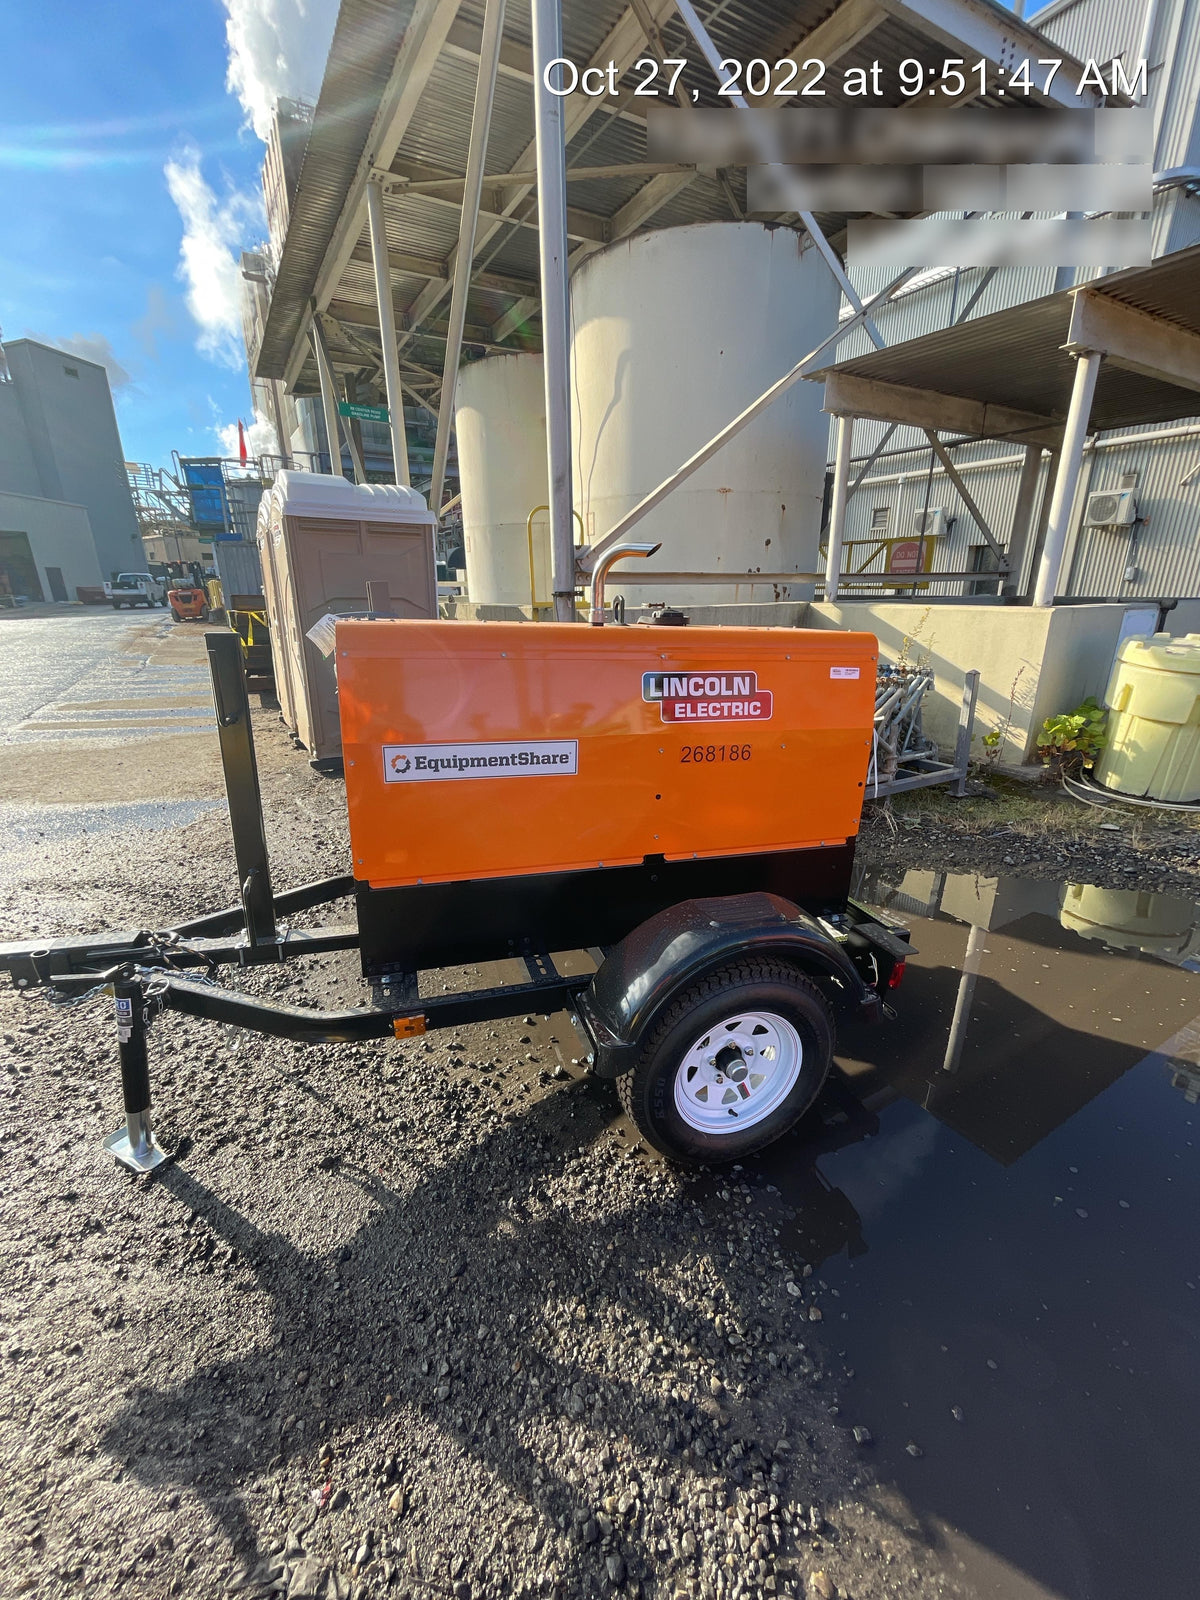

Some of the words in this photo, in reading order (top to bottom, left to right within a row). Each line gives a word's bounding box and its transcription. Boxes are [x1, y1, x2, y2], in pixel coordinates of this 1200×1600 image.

[896, 551, 905, 559] DO
[649, 676, 750, 697] LINCOLN
[674, 701, 761, 718] ELECTRIC
[414, 752, 570, 772] EquipmentShare
[680, 744, 752, 763] 268186
